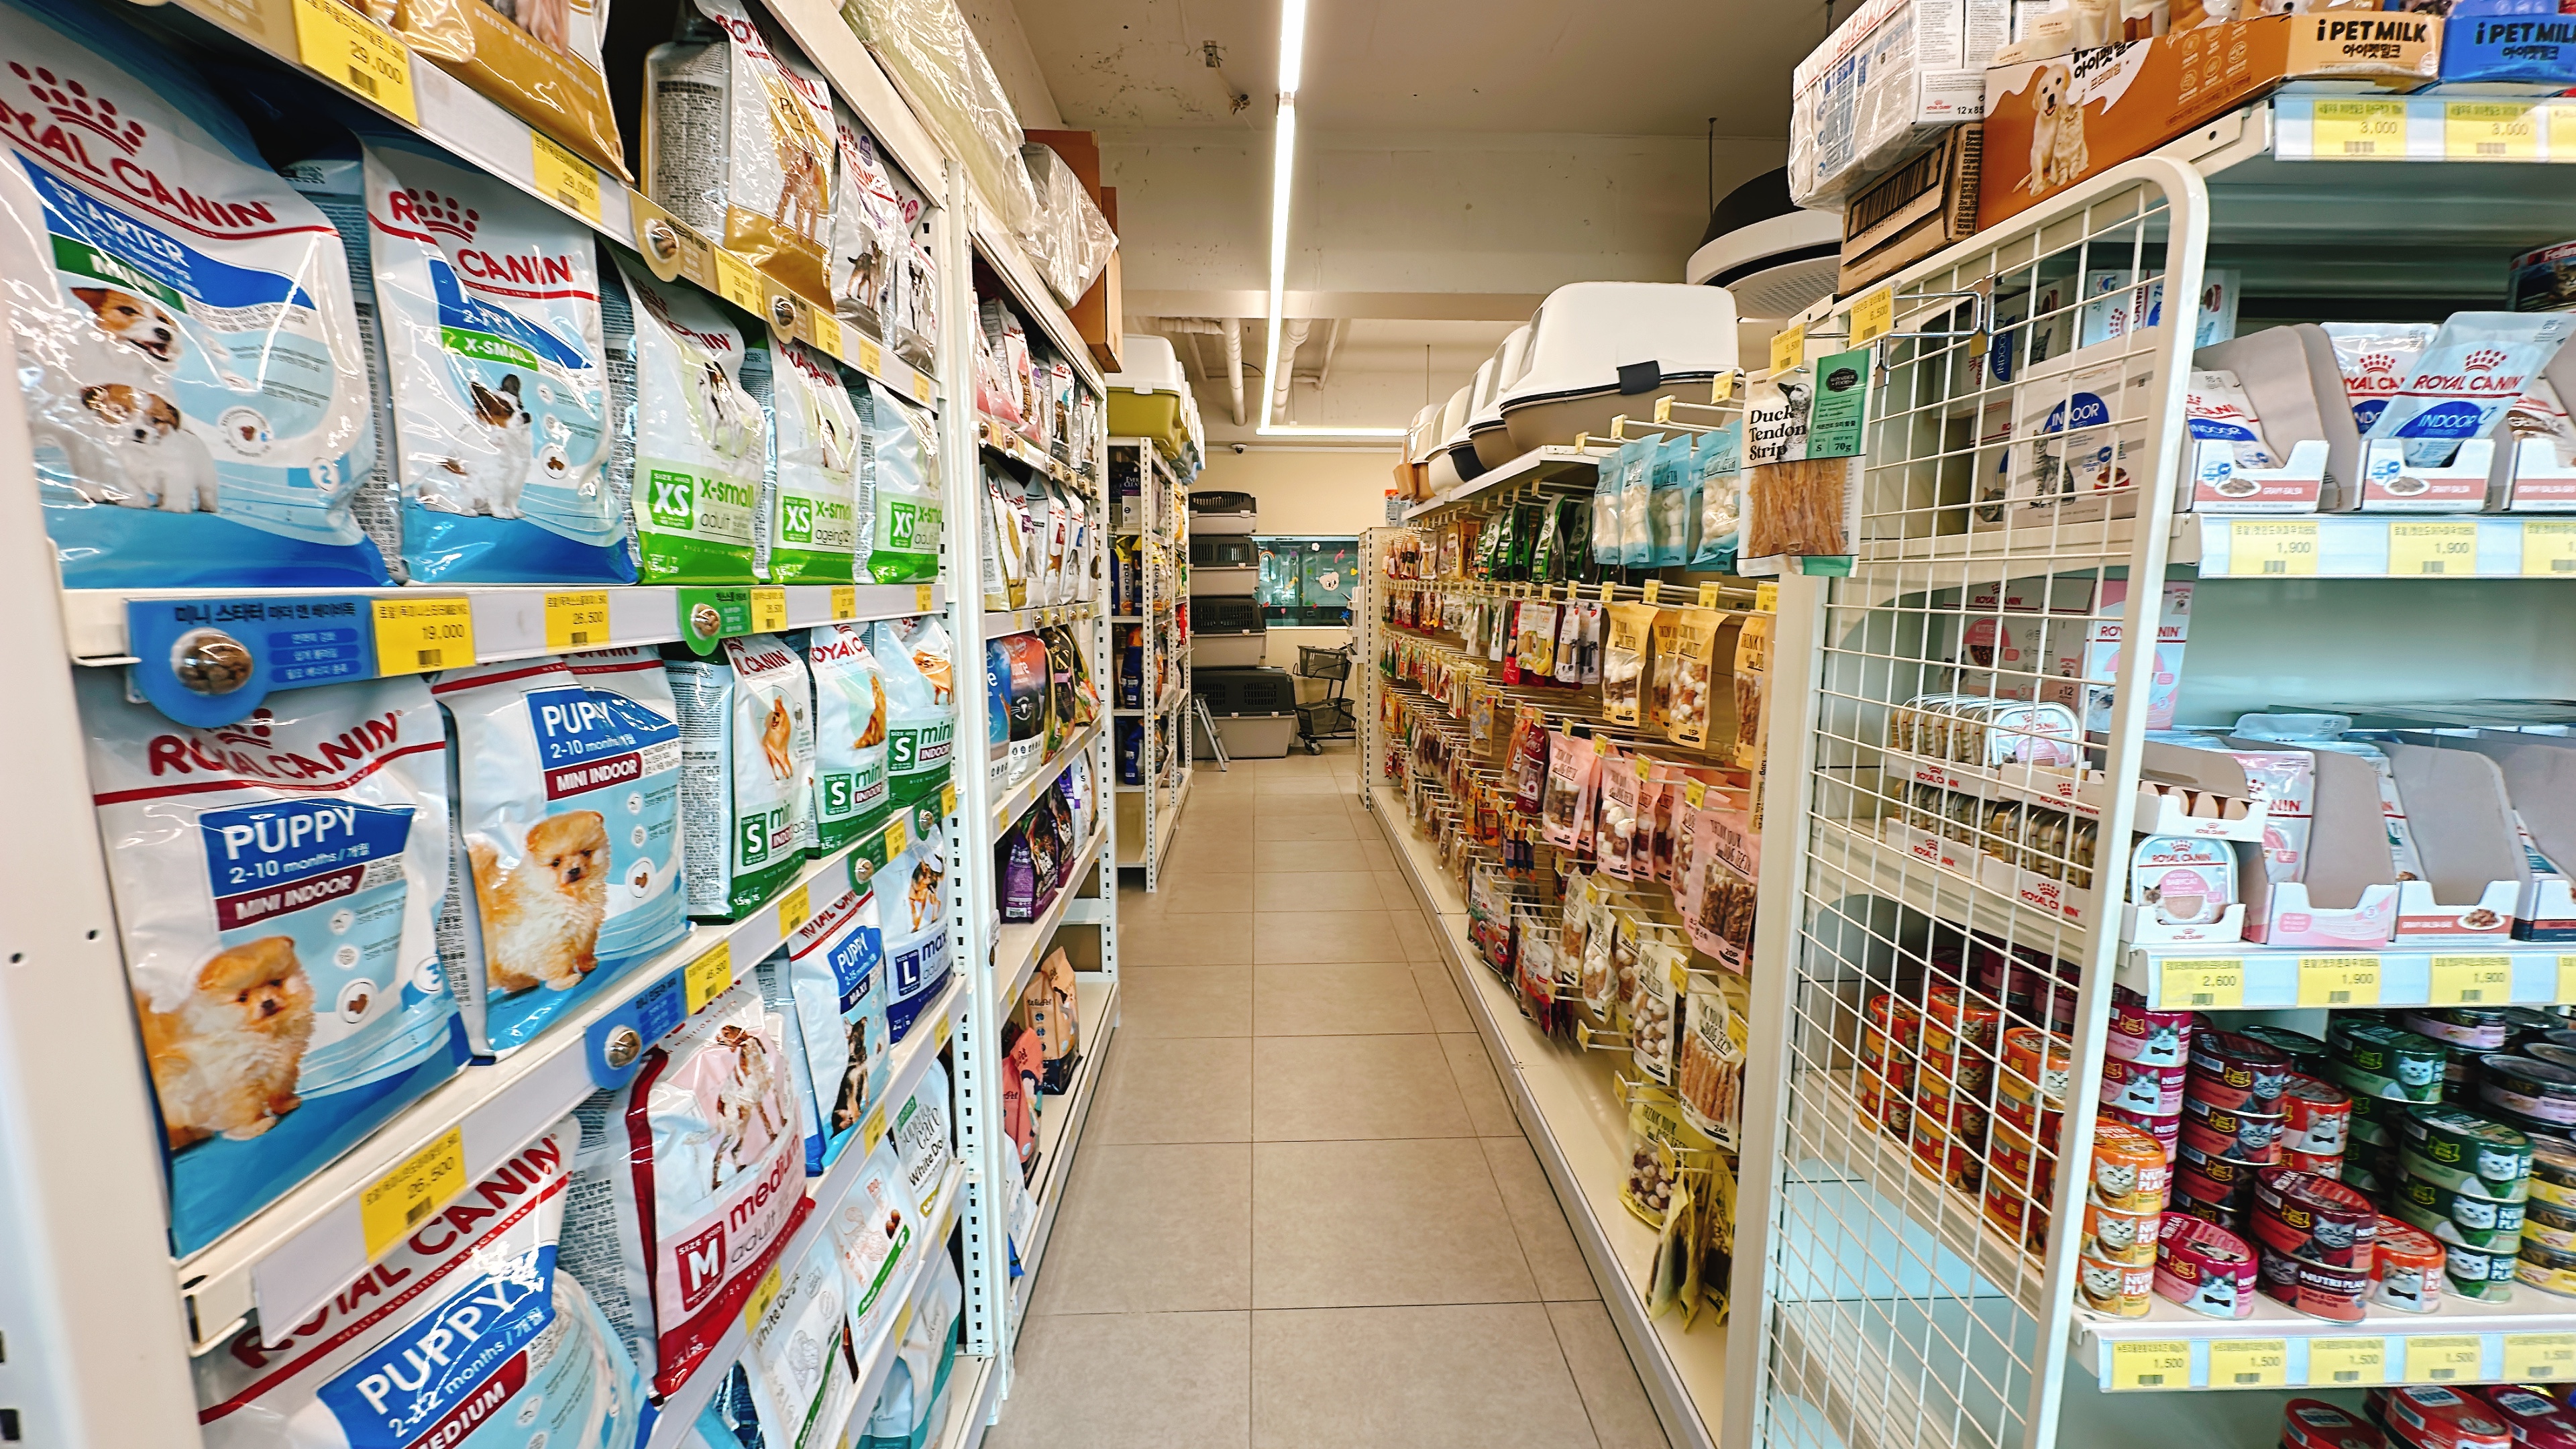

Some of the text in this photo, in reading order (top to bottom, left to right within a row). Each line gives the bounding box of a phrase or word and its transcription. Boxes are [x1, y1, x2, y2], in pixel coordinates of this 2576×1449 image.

[2343, 43, 2401, 58] 아이펫밀크
[2502, 45, 2559, 61] 아이펫밀크
[109, 157, 277, 228] CANIN
[458, 249, 574, 286] CANIN
[2413, 374, 2525, 390] ROYAL CANIN
[1750, 405, 1794, 425] Duck
[2051, 402, 2100, 427] INOOR
[1750, 423, 1807, 443] Tendon
[1749, 442, 1787, 461] Strip
[1835, 442, 1852, 452] 70g
[653, 482, 688, 517] XS
[700, 512, 731, 529] adult
[786, 504, 811, 533] XS
[894, 508, 914, 537] XS
[216, 602, 266, 623] 스타터
[745, 649, 792, 673] CANIN
[920, 718, 955, 745] mini
[274, 710, 398, 780] CANIN
[550, 739, 584, 759] 2-10
[894, 737, 912, 762] S
[555, 769, 589, 792] MINI
[590, 759, 638, 784] INDOOR
[830, 781, 847, 806] S
[223, 805, 357, 859] PUPPY
[747, 823, 762, 853] S
[229, 861, 280, 885] 2-10
[283, 851, 337, 874] months
[2151, 853, 2212, 863] ROYAL CANIN
[235, 875, 354, 920] MINI INDOOR
[902, 961, 917, 985] L
[2202, 975, 2237, 987] 2,600
[2341, 973, 2374, 985] 1,900
[908, 1153, 934, 1186] White
[409, 1136, 561, 1256] CANIN
[678, 1238, 702, 1256] SIZE
[337, 1313, 380, 1341] HEALTH
[385, 1263, 455, 1311] NUTRITION
[500, 1207, 529, 1229] 1968
[688, 1238, 719, 1292] M
[356, 1282, 516, 1415] PUPPY
[445, 1340, 506, 1395] months
